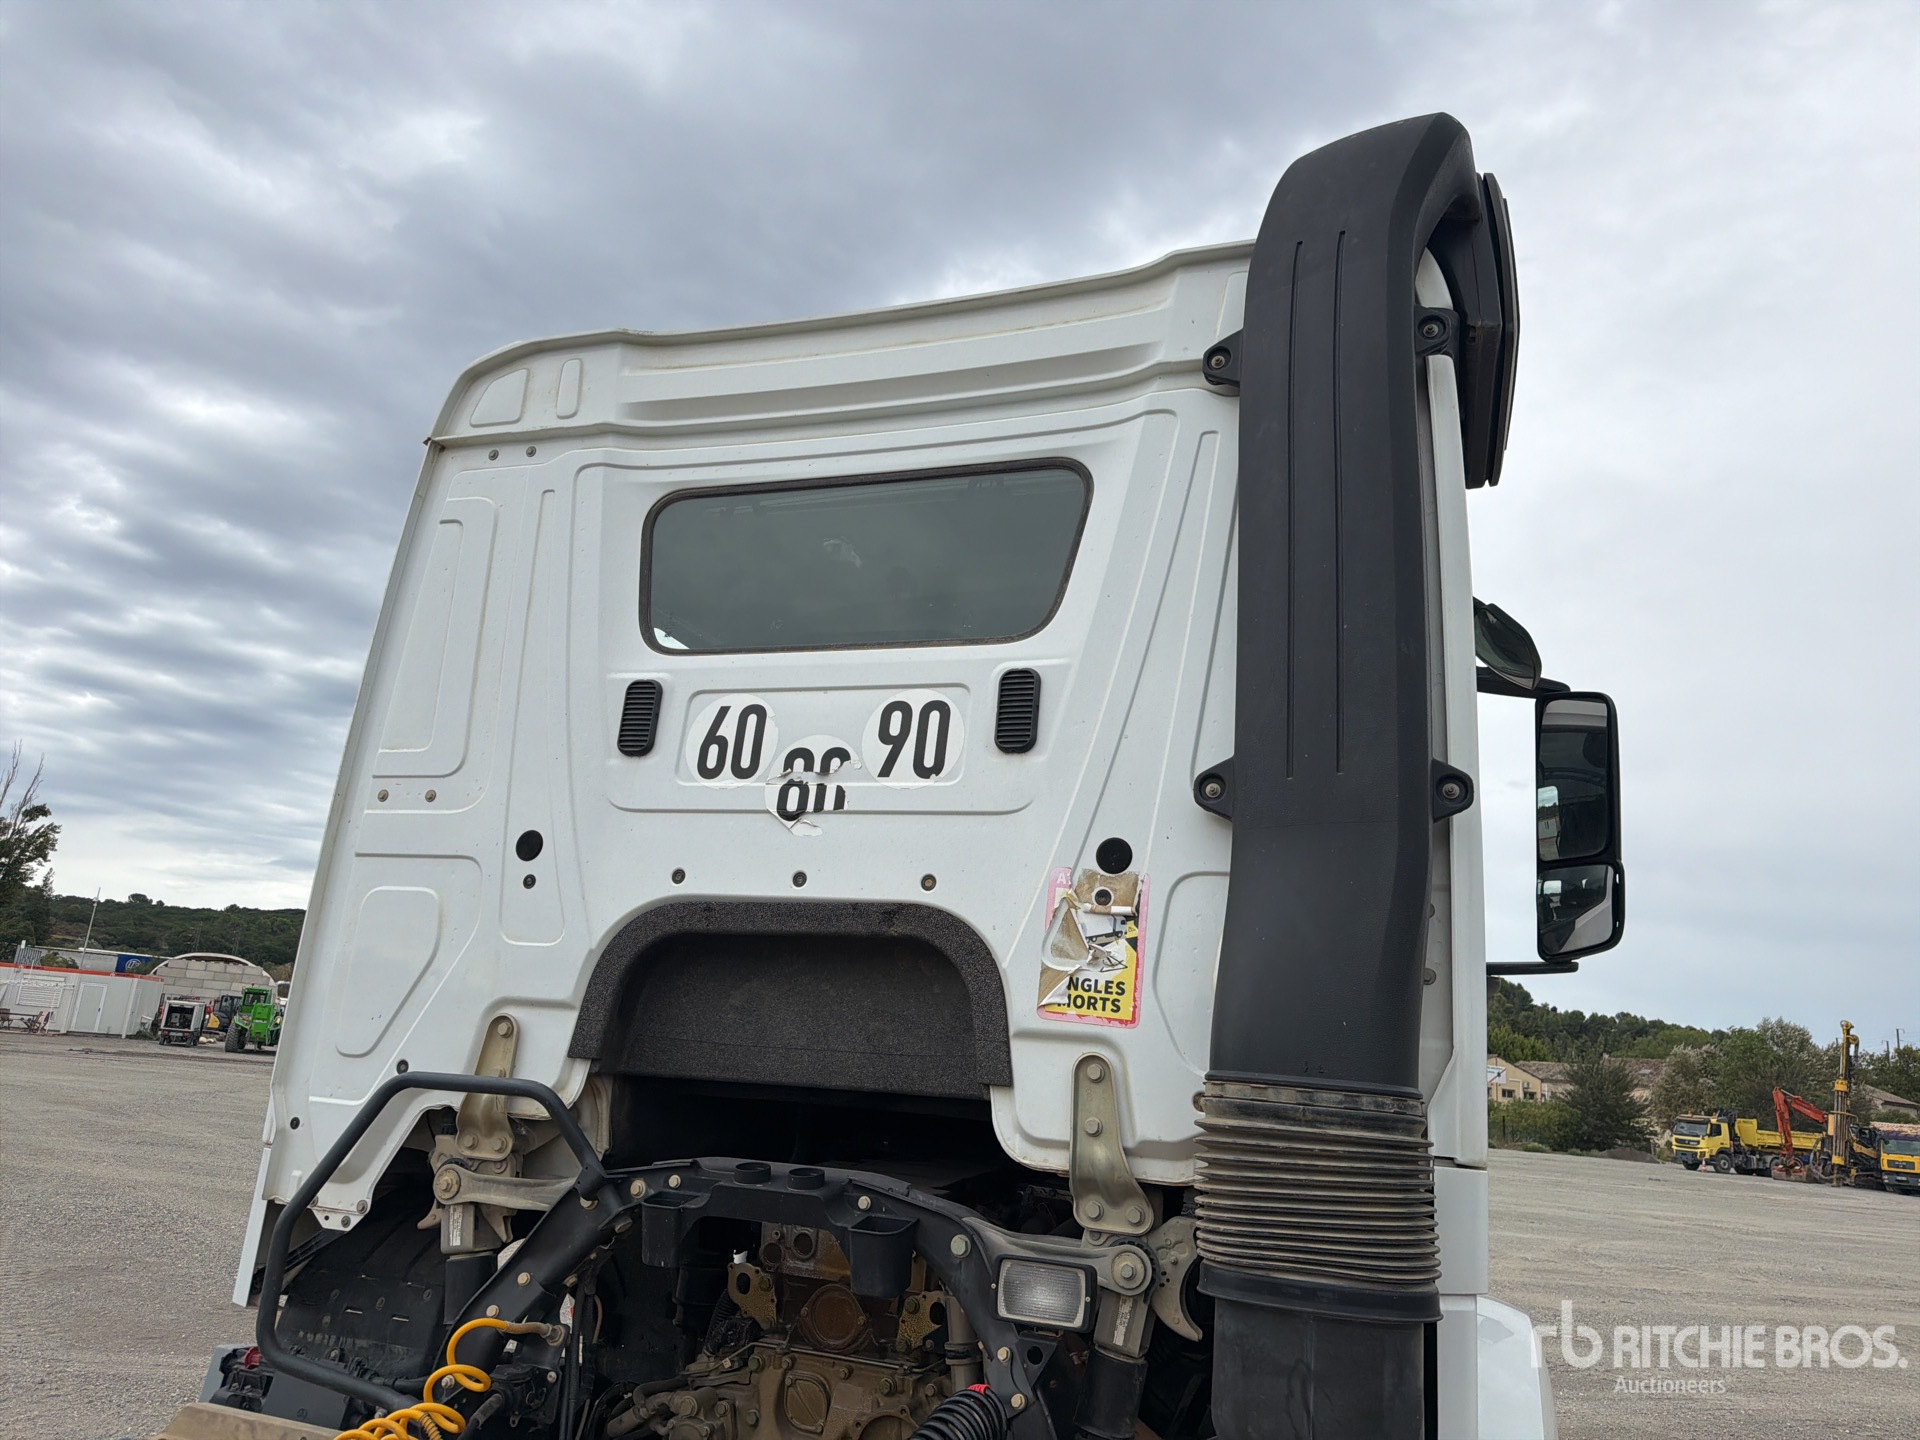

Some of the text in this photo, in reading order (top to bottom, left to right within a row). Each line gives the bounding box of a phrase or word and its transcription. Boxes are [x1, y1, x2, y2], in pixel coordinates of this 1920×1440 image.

[697, 704, 767, 780] 60
[877, 700, 951, 779] 90
[1067, 976, 1126, 996] NGLES
